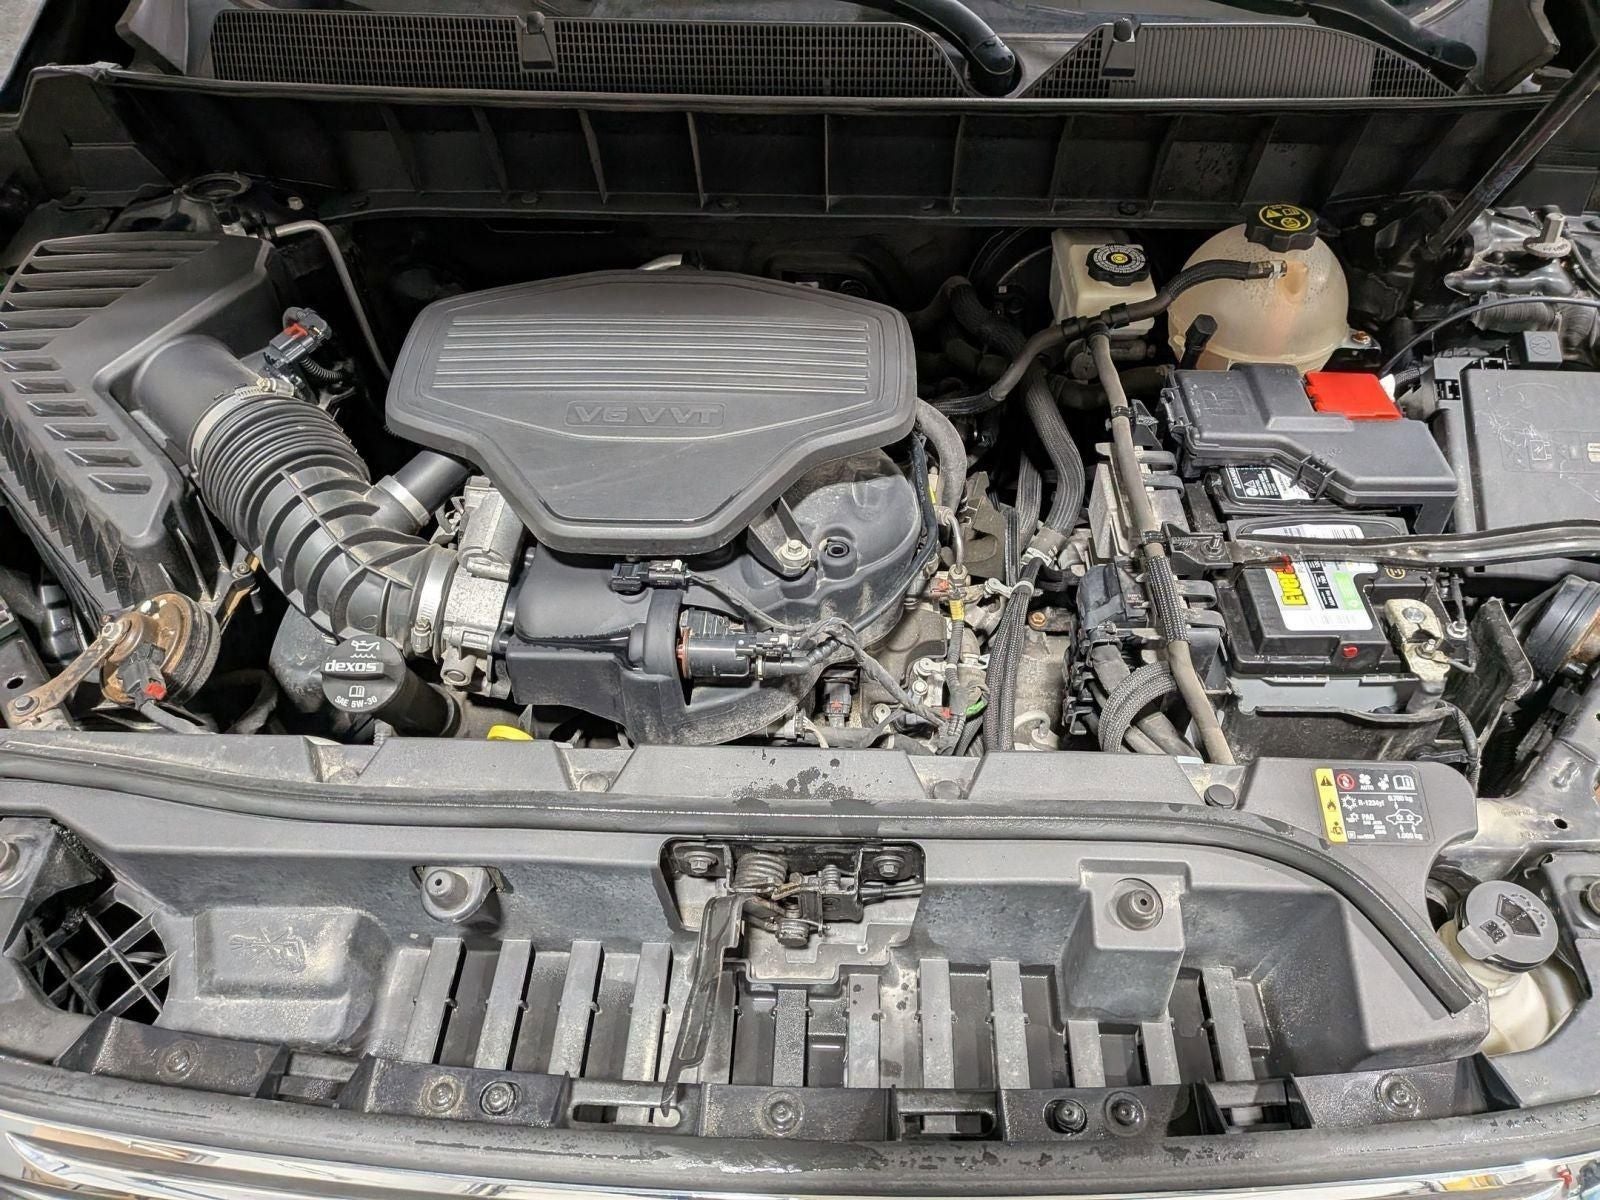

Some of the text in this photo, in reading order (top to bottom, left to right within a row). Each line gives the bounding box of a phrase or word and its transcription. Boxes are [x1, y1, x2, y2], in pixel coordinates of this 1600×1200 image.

[574, 406, 719, 424] V6 VVT
[324, 660, 377, 672] dexos
[334, 695, 378, 708] SAE 5W-30
